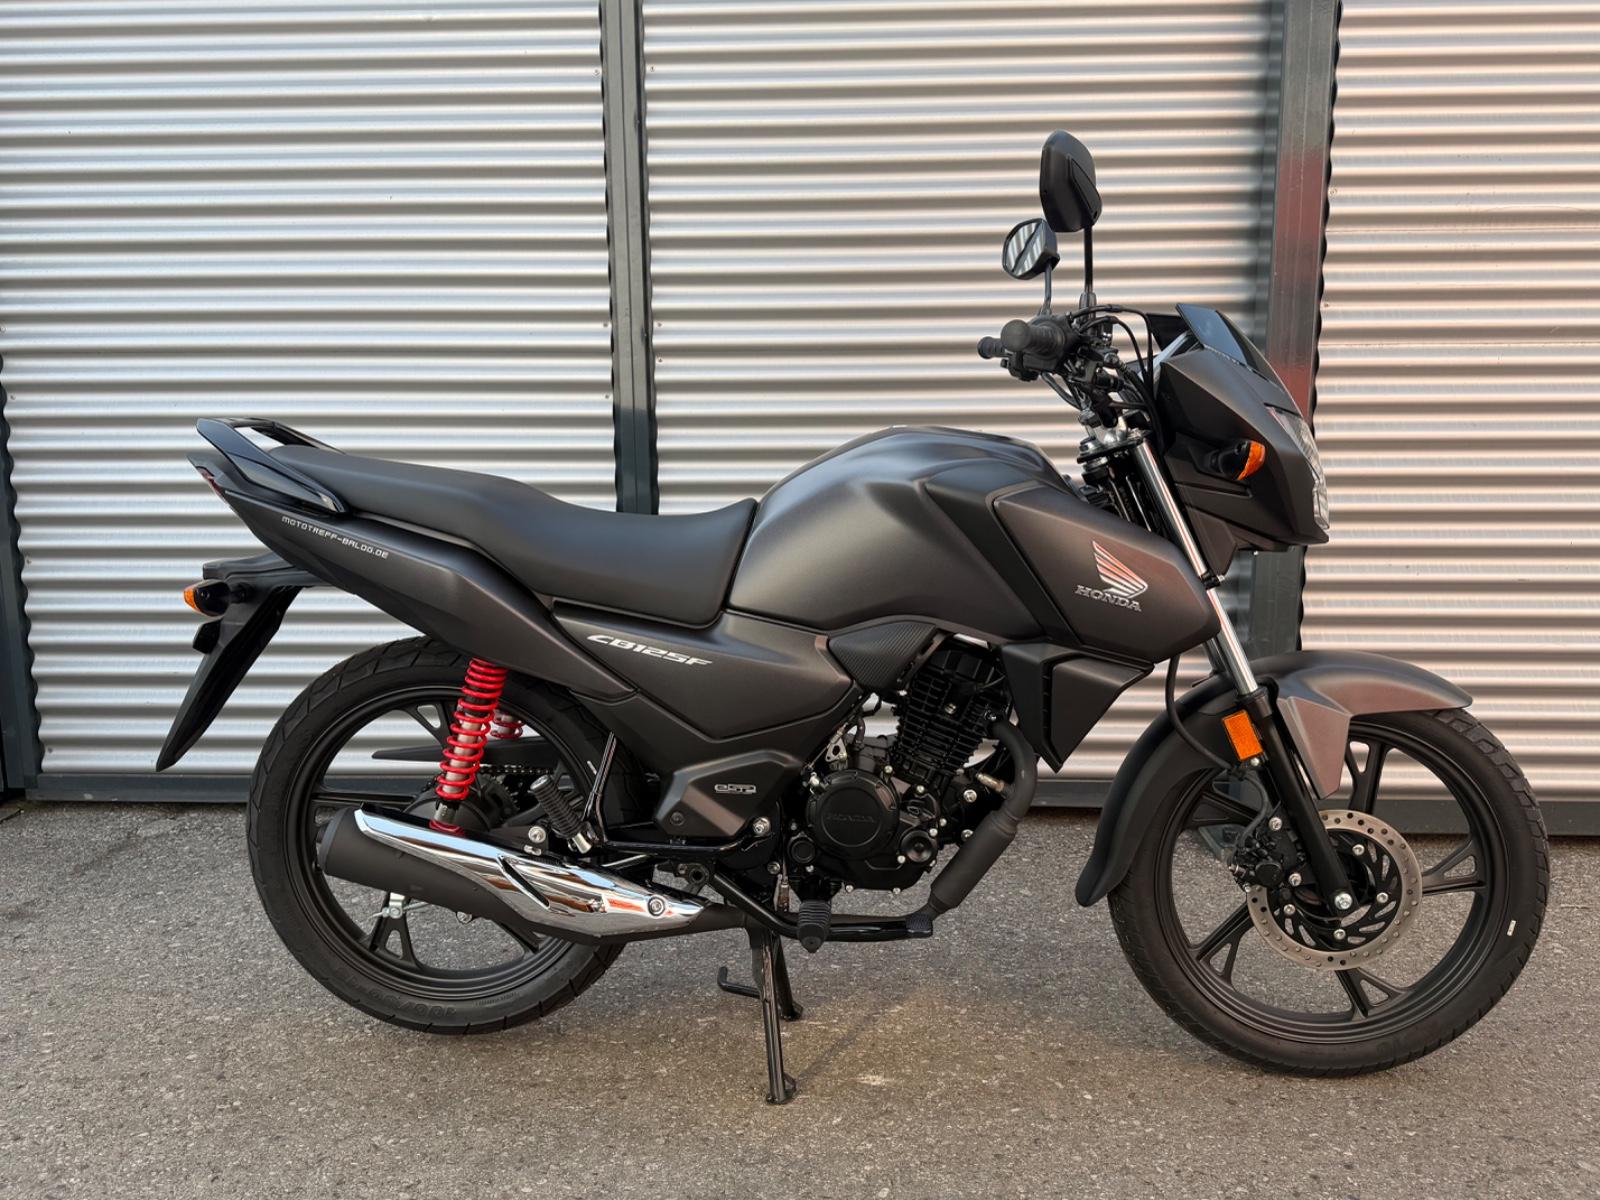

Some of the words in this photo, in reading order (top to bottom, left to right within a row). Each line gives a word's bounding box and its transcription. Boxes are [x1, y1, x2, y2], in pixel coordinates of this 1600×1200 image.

[1074, 584, 1142, 612] HONDA
[586, 634, 713, 666] CB125F
[826, 812, 877, 825] HONDA
